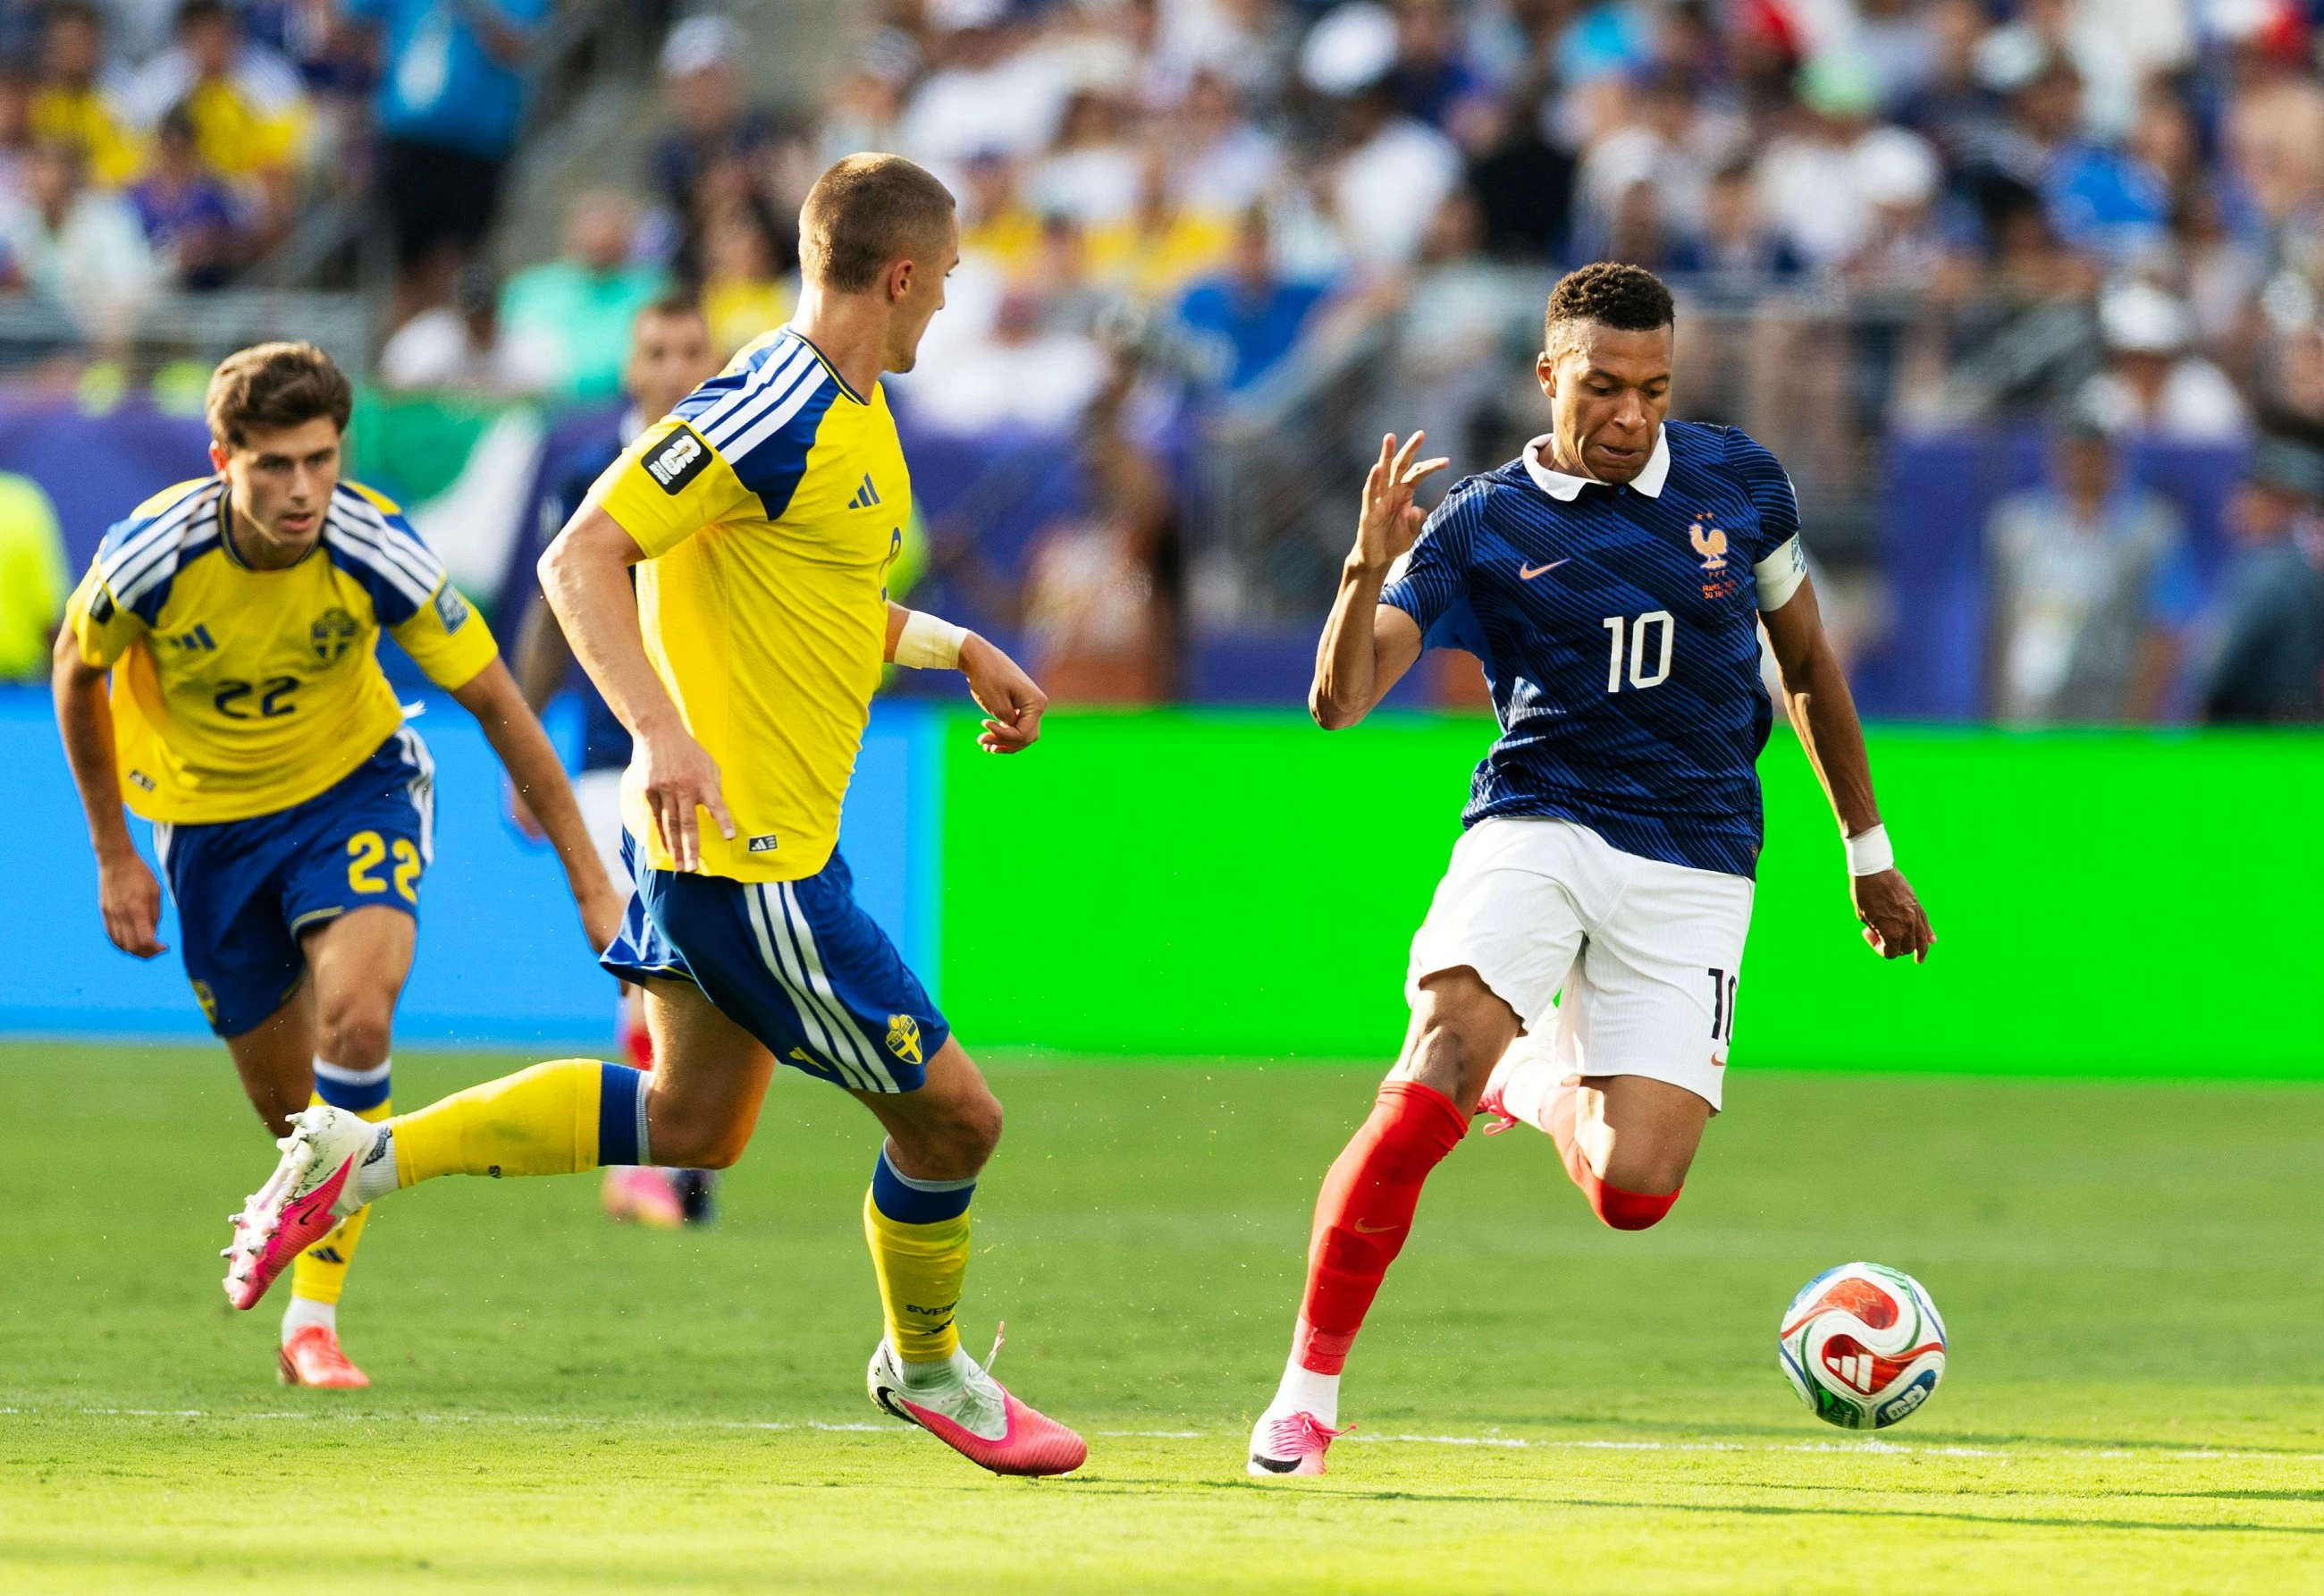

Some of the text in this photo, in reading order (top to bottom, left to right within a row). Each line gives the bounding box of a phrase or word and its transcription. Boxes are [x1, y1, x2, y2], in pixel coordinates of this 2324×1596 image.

[1603, 610, 1675, 693] 10
[215, 675, 300, 720] 22
[346, 829, 422, 906] 22
